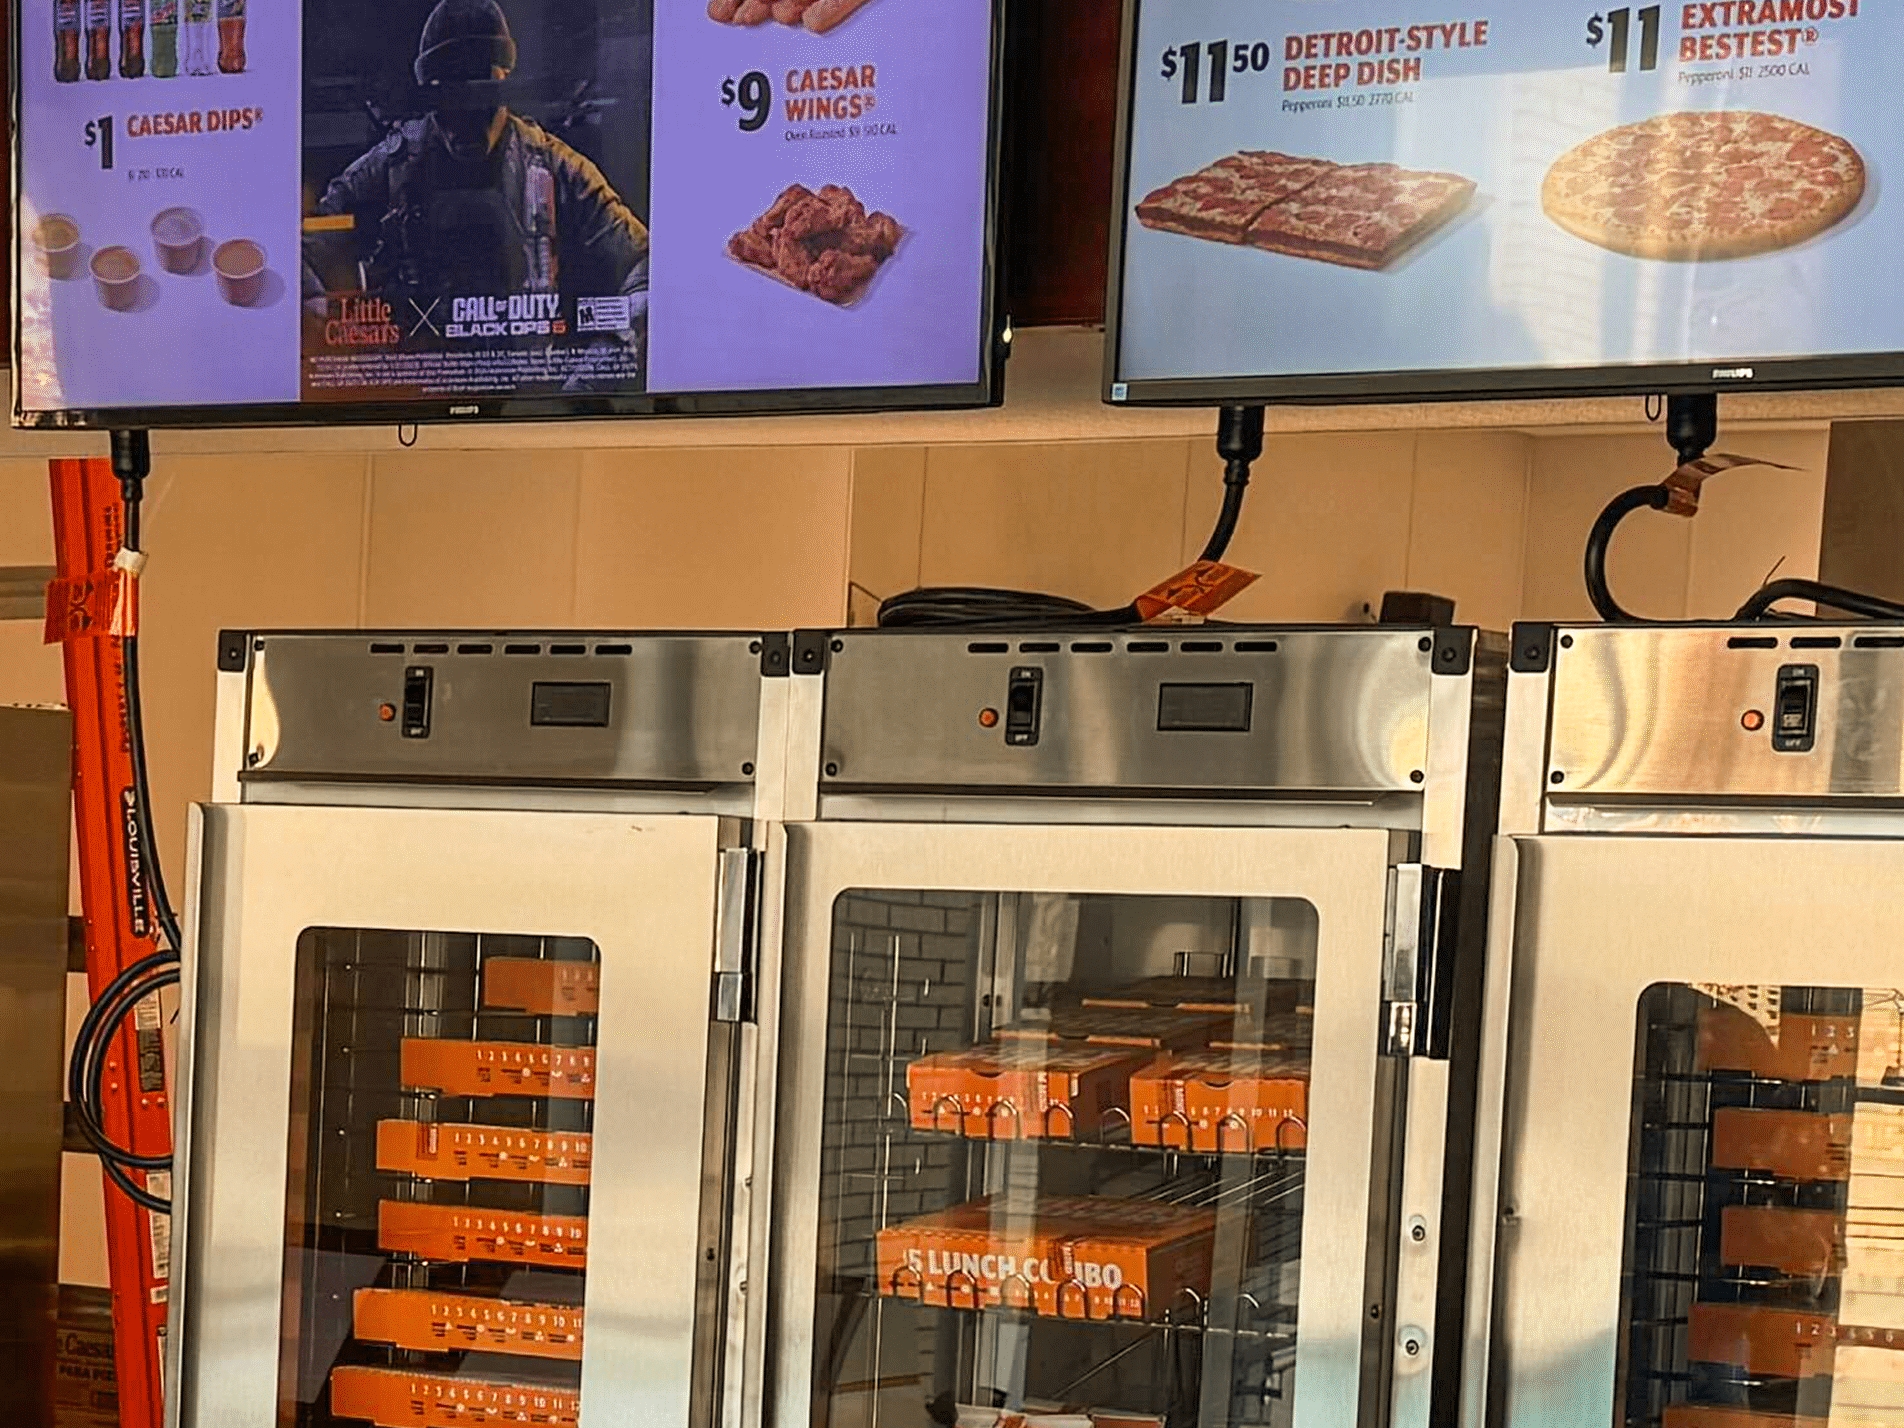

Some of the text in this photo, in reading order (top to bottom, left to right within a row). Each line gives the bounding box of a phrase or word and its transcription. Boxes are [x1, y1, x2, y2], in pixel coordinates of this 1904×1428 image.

[1284, 20, 1489, 62] DETROIT-STYLE
[1586, 4, 1660, 73] $11
[1282, 57, 1421, 92] DEEP DISH
[1788, 62, 1810, 76] CAL
[721, 64, 875, 131] $9 CAESAR
[84, 115, 113, 169] $1
[127, 111, 202, 138] CAESAR
[340, 293, 561, 324] Little CALL DUTY
[445, 323, 507, 338] BLACK
[511, 322, 550, 336] OPS
[125, 808, 146, 935] LOUISVILLE
[928, 1250, 1123, 1289] LUNCH COBO
